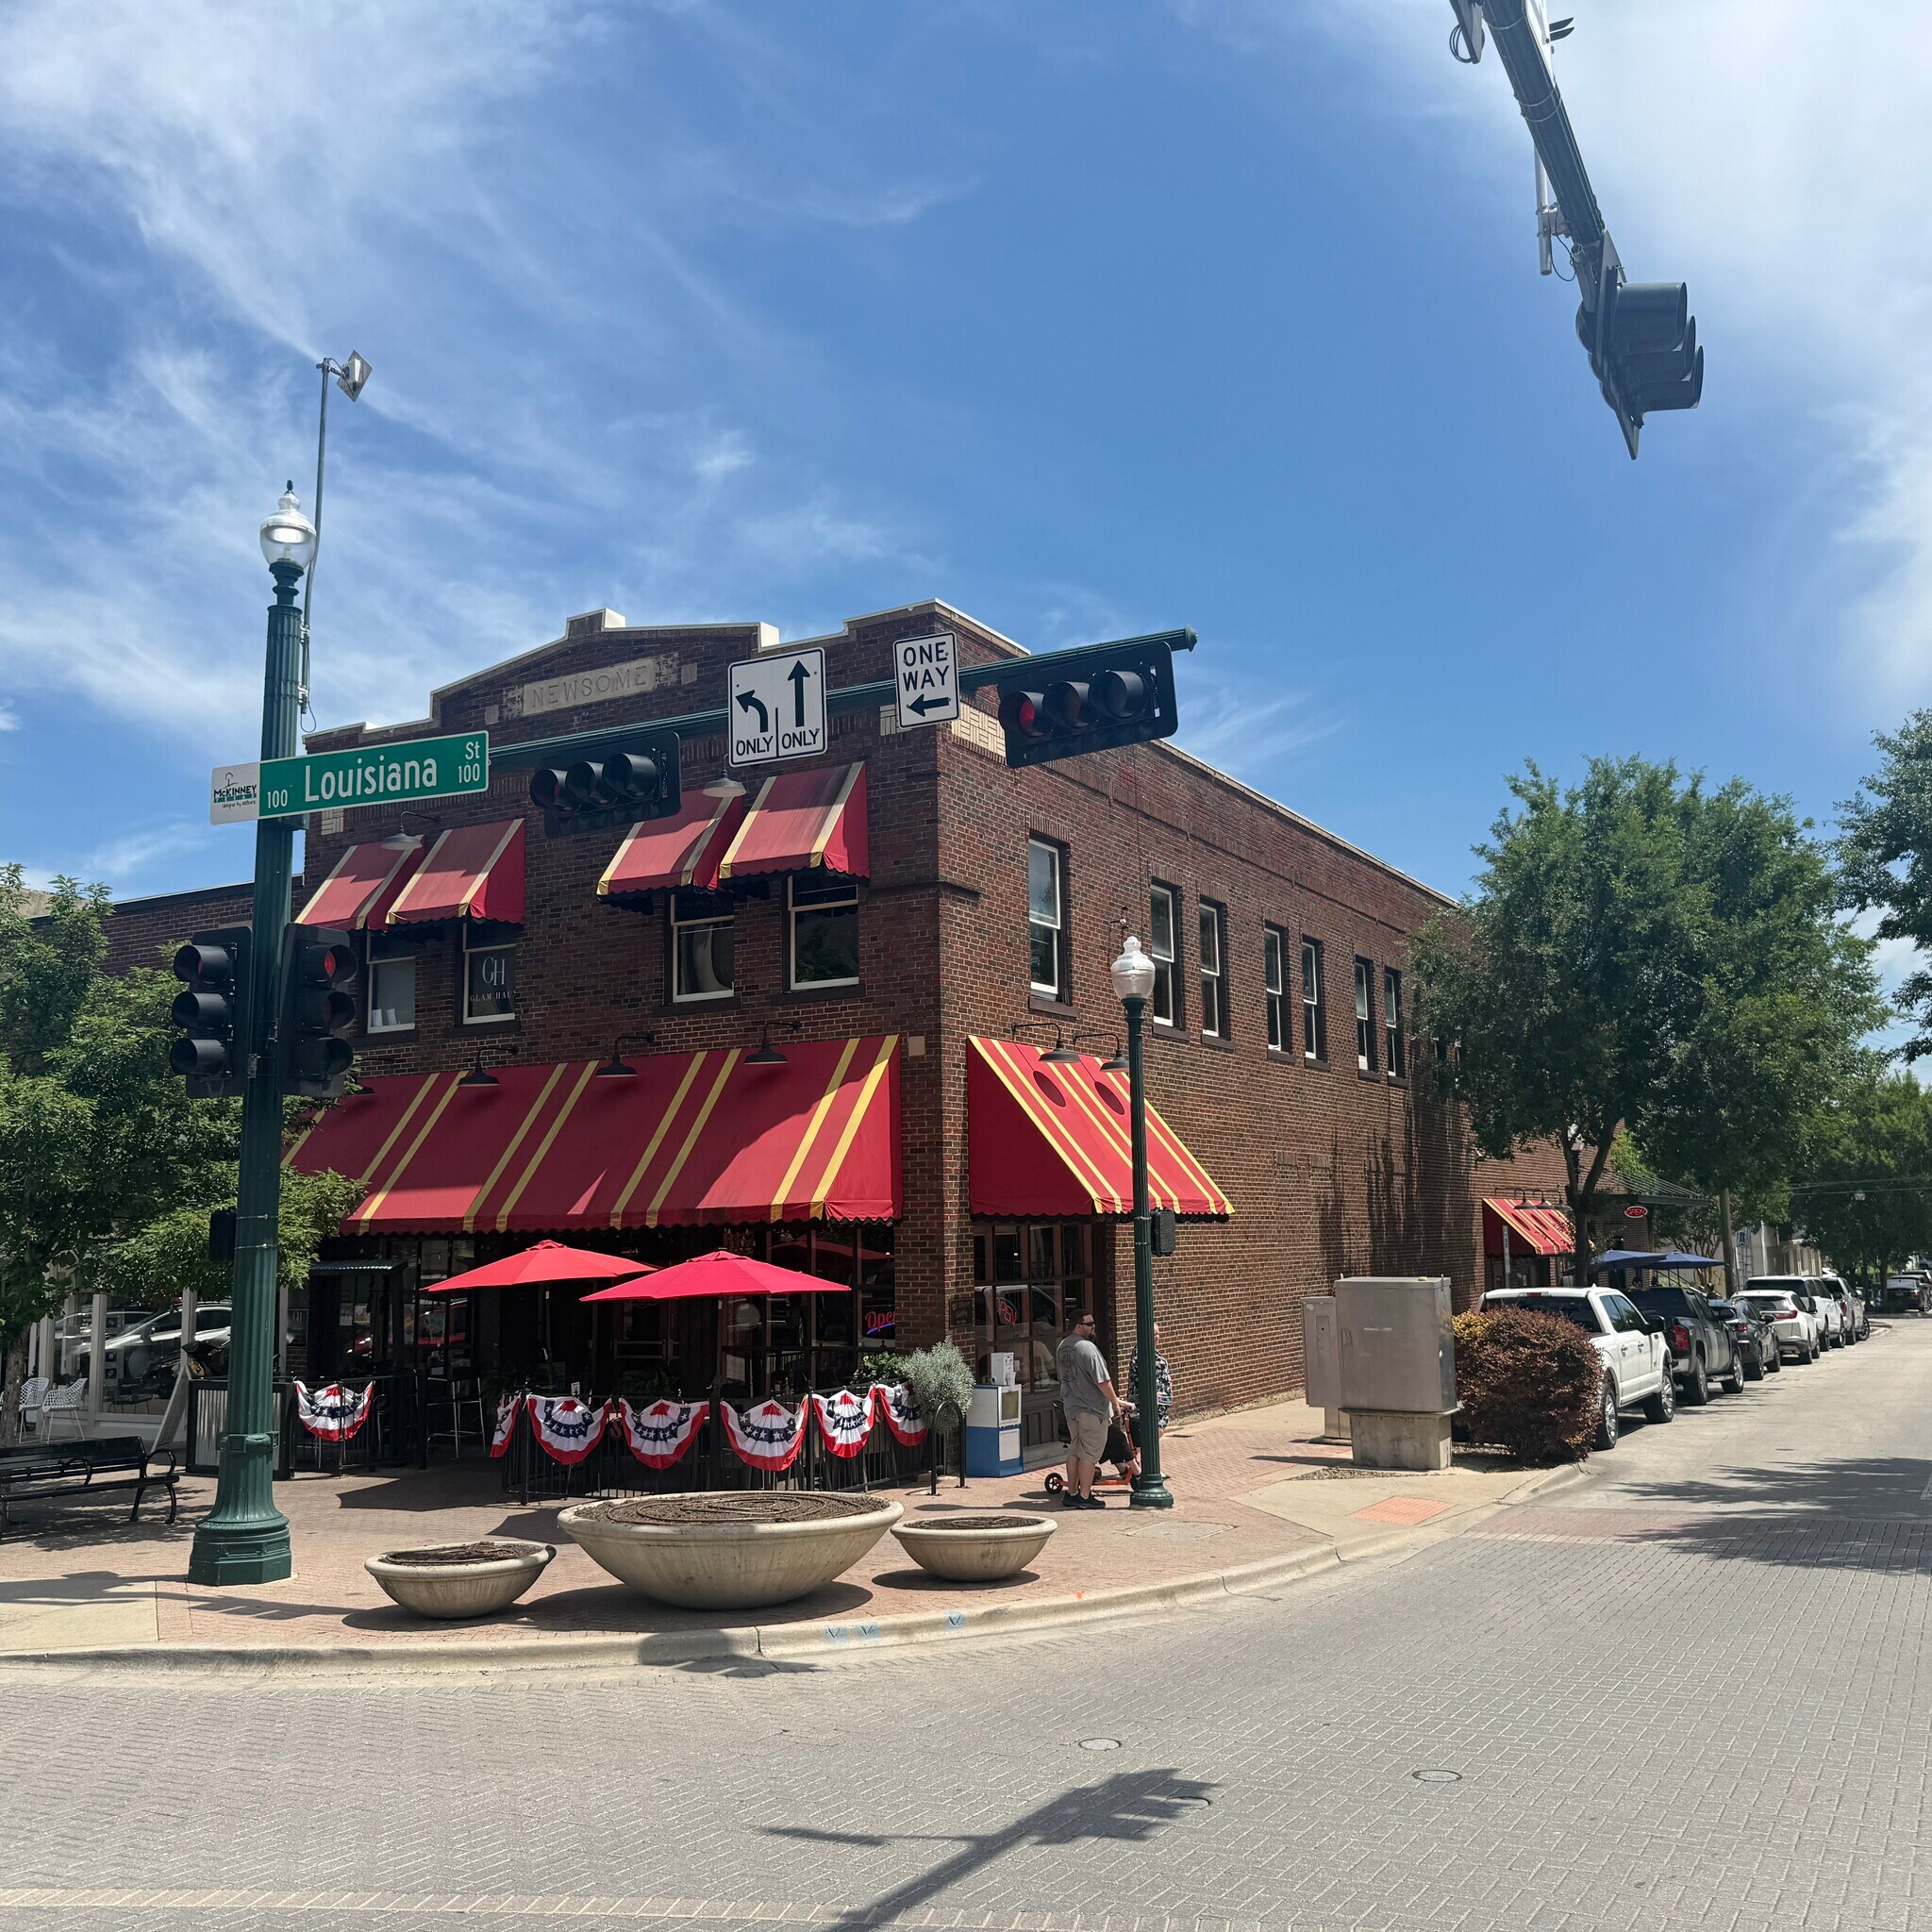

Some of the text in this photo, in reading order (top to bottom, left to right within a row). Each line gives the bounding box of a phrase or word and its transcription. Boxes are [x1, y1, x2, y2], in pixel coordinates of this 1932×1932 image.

[903, 641, 947, 667] ONE
[532, 665, 647, 708] NEWSOME
[903, 665, 950, 691] WAY
[736, 728, 820, 756] ONLY ONLY
[267, 741, 480, 808] 100 Louisiana St
[458, 762, 480, 783] 100
[482, 956, 506, 986] GH
